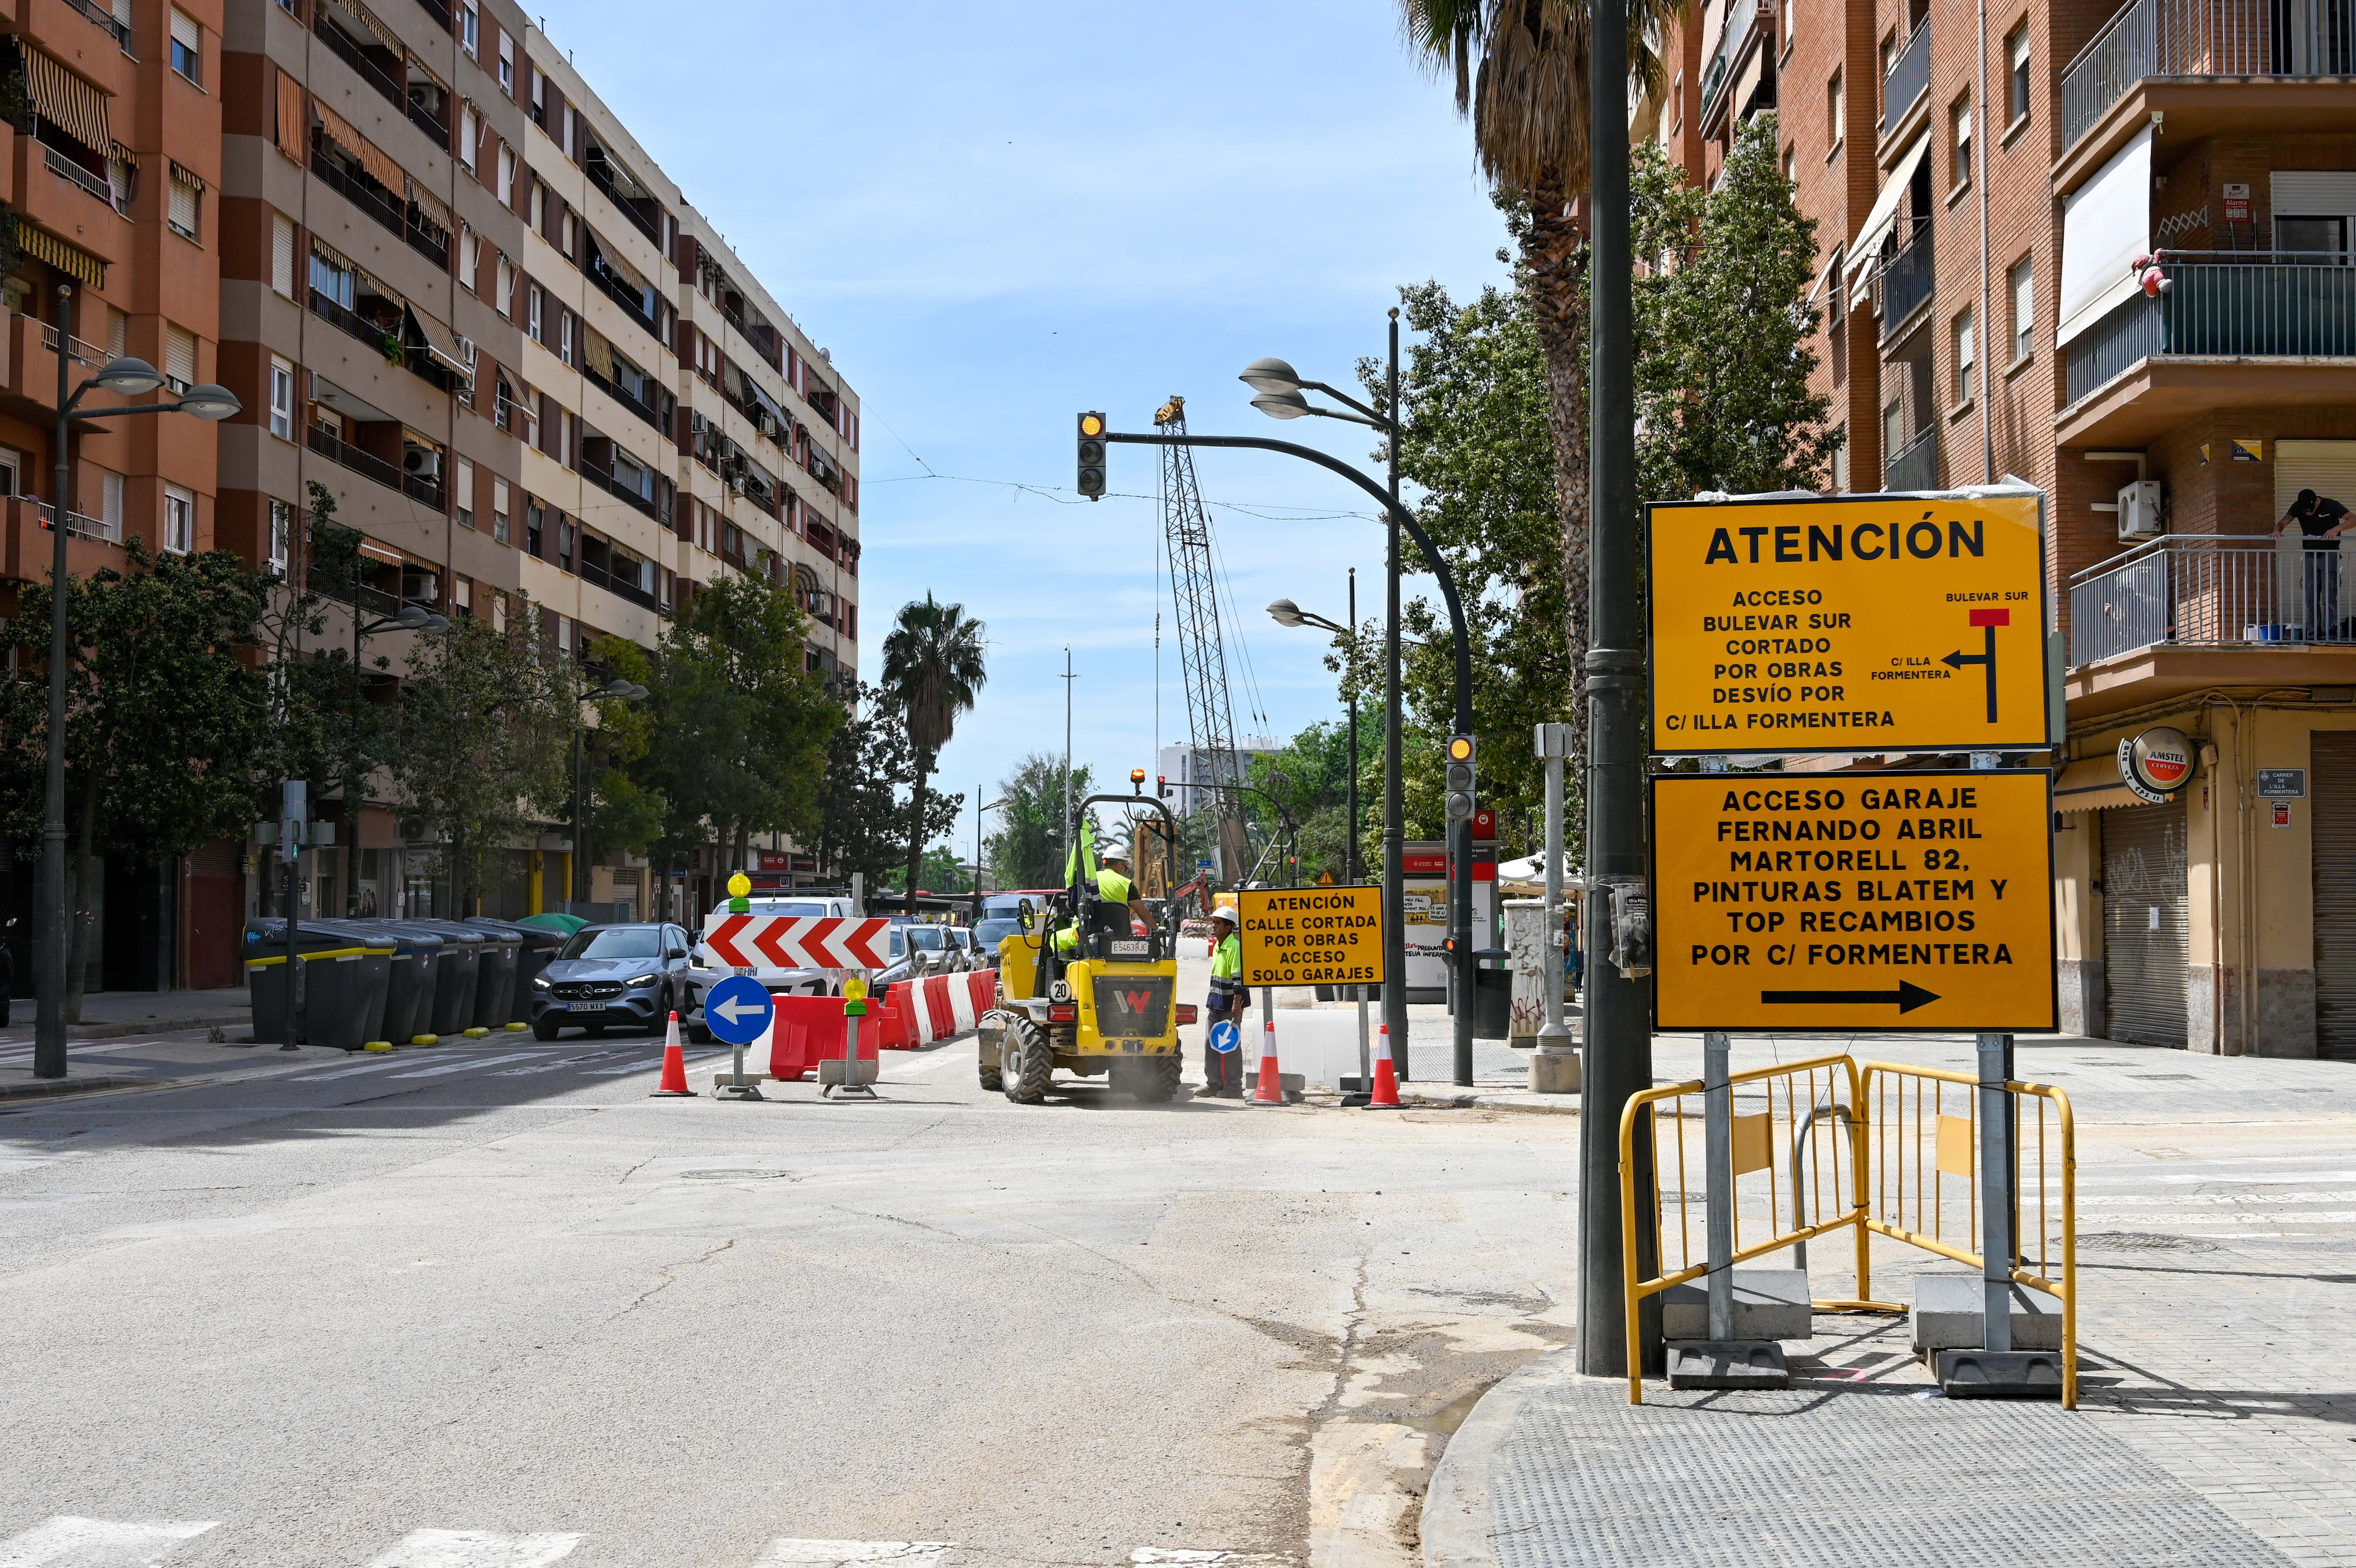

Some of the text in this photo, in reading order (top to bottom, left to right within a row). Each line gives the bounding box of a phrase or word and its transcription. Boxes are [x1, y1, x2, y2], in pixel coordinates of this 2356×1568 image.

[1705, 512, 1983, 564] ATENCIÓN
[1733, 590, 1821, 606] ACCESO
[1947, 592, 2028, 602] BULEVAR SUR
[1704, 613, 1850, 631] BULEVAR SUR
[1726, 638, 1830, 655] CORTADO
[1715, 662, 1842, 679] POR OBRAS
[1872, 670, 1950, 679] FORMENTERA
[1714, 683, 1844, 703] DESVÍO POR
[1666, 711, 1894, 730] C/ ILLA FORMENTERA
[2150, 751, 2184, 762] AMSTEL
[2125, 770, 2133, 781] LA
[2135, 786, 2149, 798] PAZ
[1723, 788, 1977, 811] ACCESO GARAJE
[1718, 818, 1981, 841] FERNANDO ABRIL
[1731, 849, 1968, 871] MARTORELL 82,
[1694, 879, 2007, 902] PINTURAS BLATEM Y
[1267, 893, 1354, 911] ATENCIÓN
[1246, 916, 1376, 930] CALLE CORTADA
[1727, 910, 1975, 932] TOP RECAMBIOS
[1265, 933, 1358, 947] POR OBRAS
[1280, 951, 1345, 963] ACCESO
[1692, 944, 2012, 965] POR C/ FORMENTERA
[744, 967, 759, 976] FIAT
[1252, 967, 1373, 981] SOLO GARAJES
[1055, 983, 1066, 998] 20
